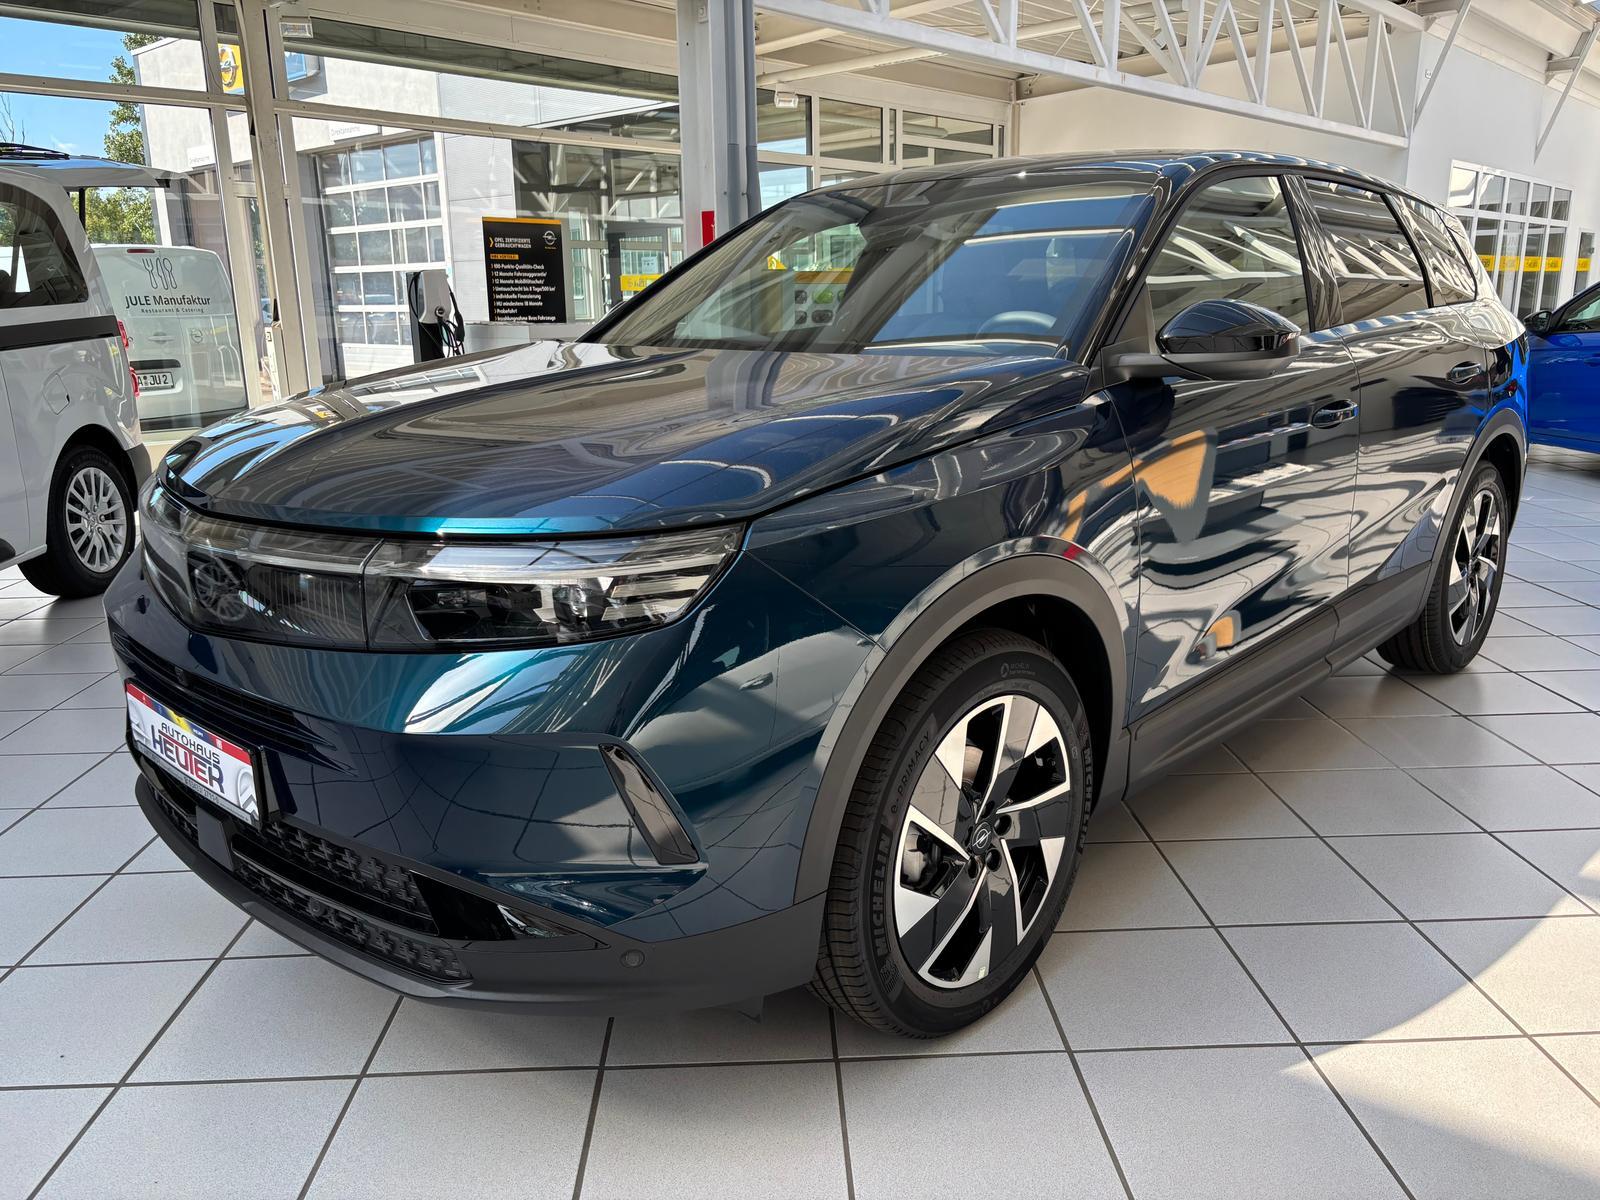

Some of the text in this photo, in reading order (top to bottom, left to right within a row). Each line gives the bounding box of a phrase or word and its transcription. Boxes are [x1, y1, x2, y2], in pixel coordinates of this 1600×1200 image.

[125, 295, 210, 309] JULE Manufaktur
[151, 725, 225, 794] HEUTER
[161, 722, 220, 764] AUTOHAUS
[873, 832, 891, 958] MICHELIN
